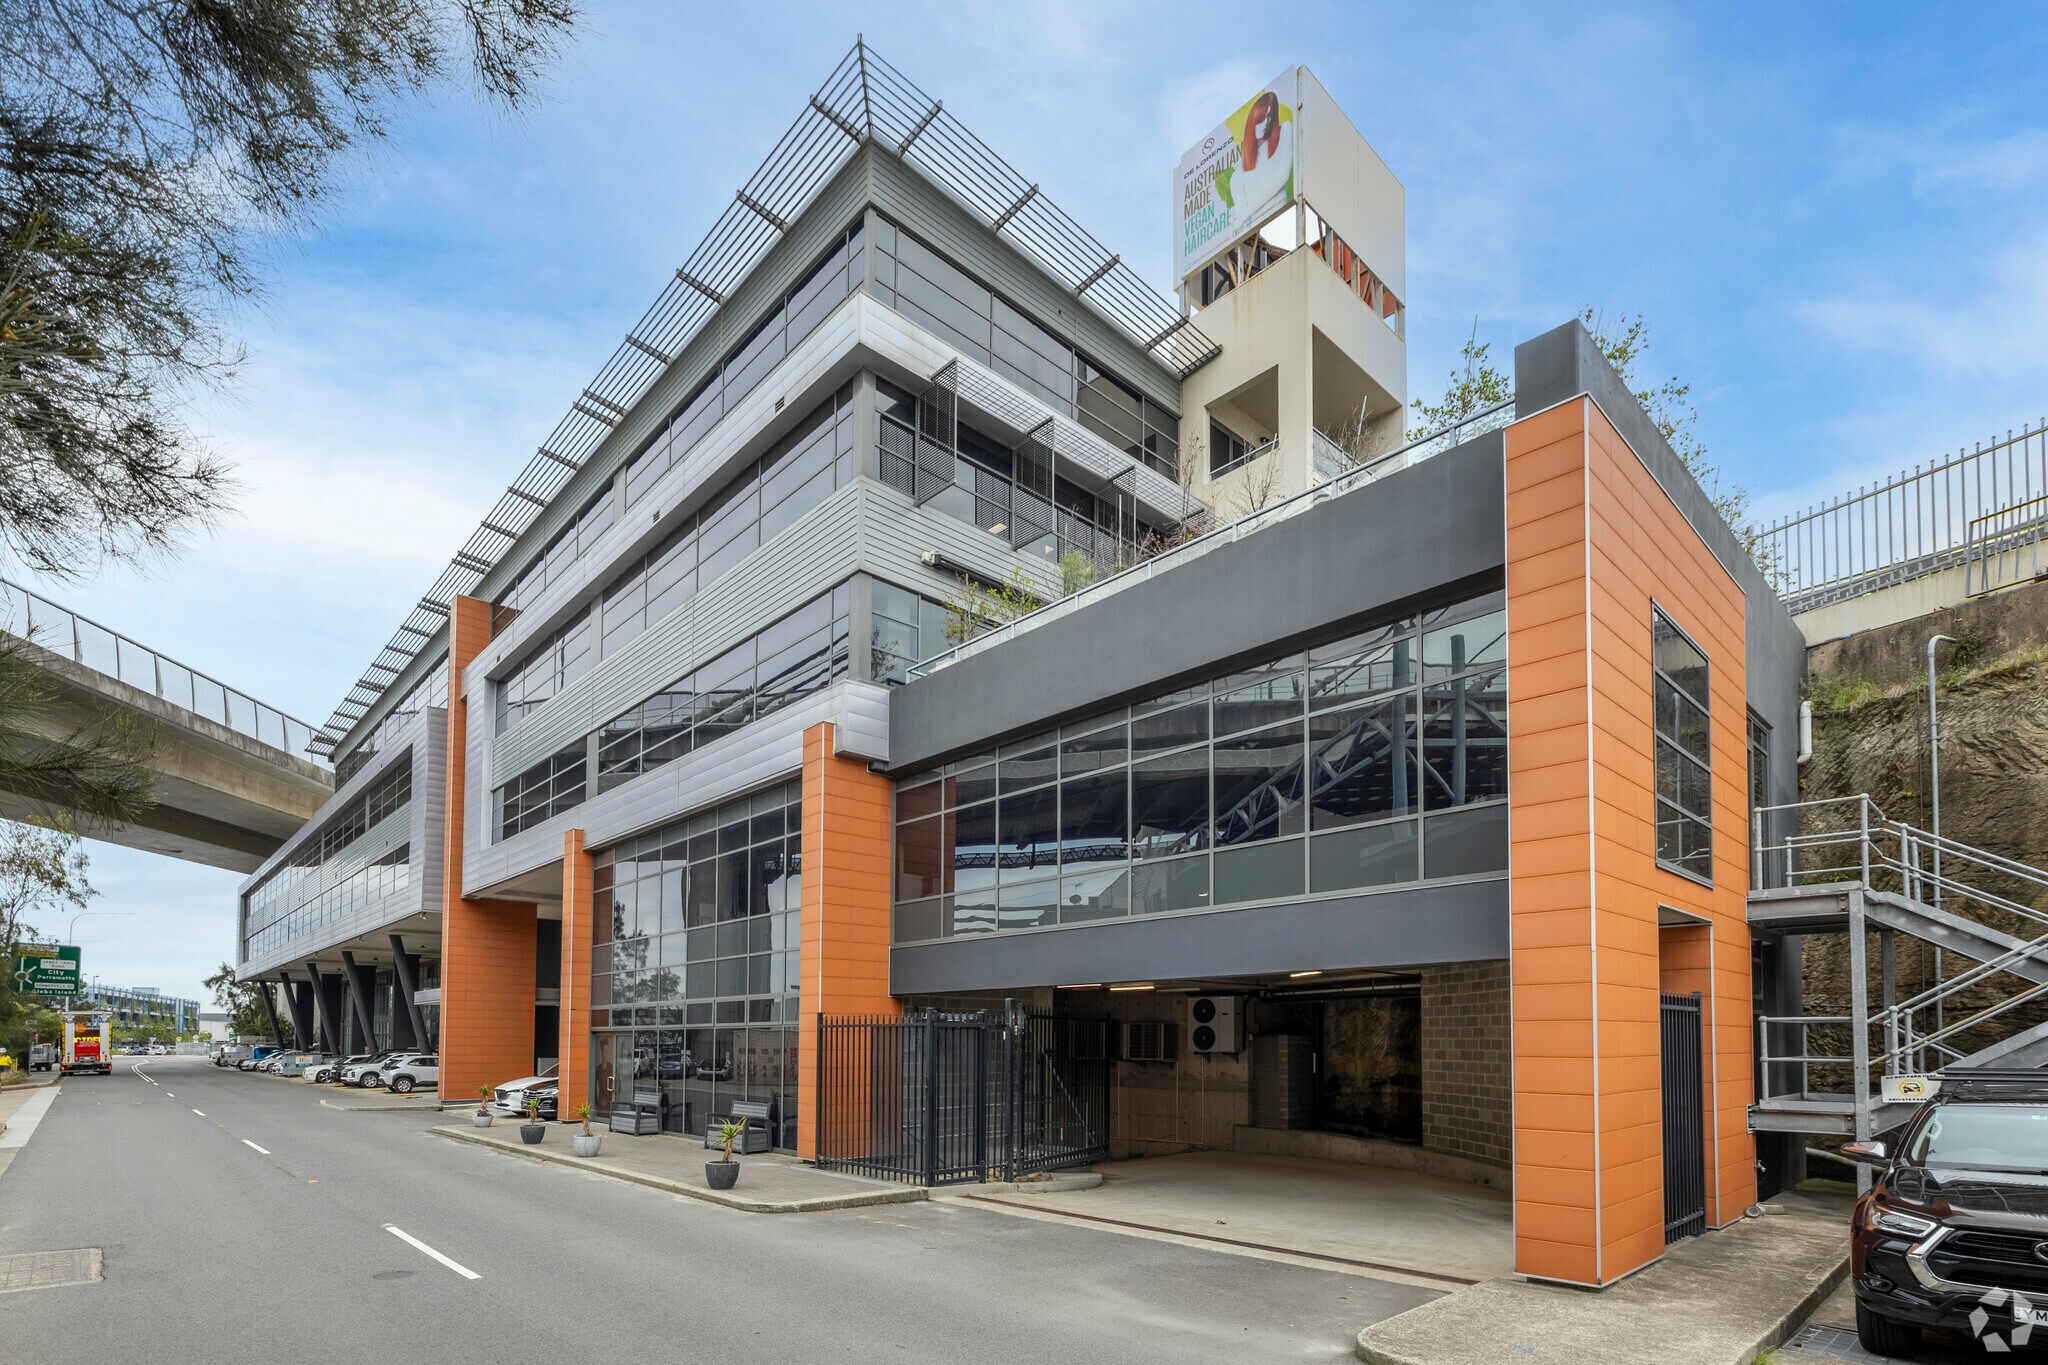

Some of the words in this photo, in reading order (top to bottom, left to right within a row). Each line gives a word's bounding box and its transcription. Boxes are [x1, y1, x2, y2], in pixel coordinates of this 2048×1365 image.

[1184, 168, 1194, 179] DE
[1196, 136, 1234, 170] LORENZO
[1184, 141, 1242, 202] AUSTRALIAN
[1184, 186, 1211, 220] MADE
[1184, 201, 1214, 238] VEGAN
[1184, 210, 1231, 256] HAIRCARE
